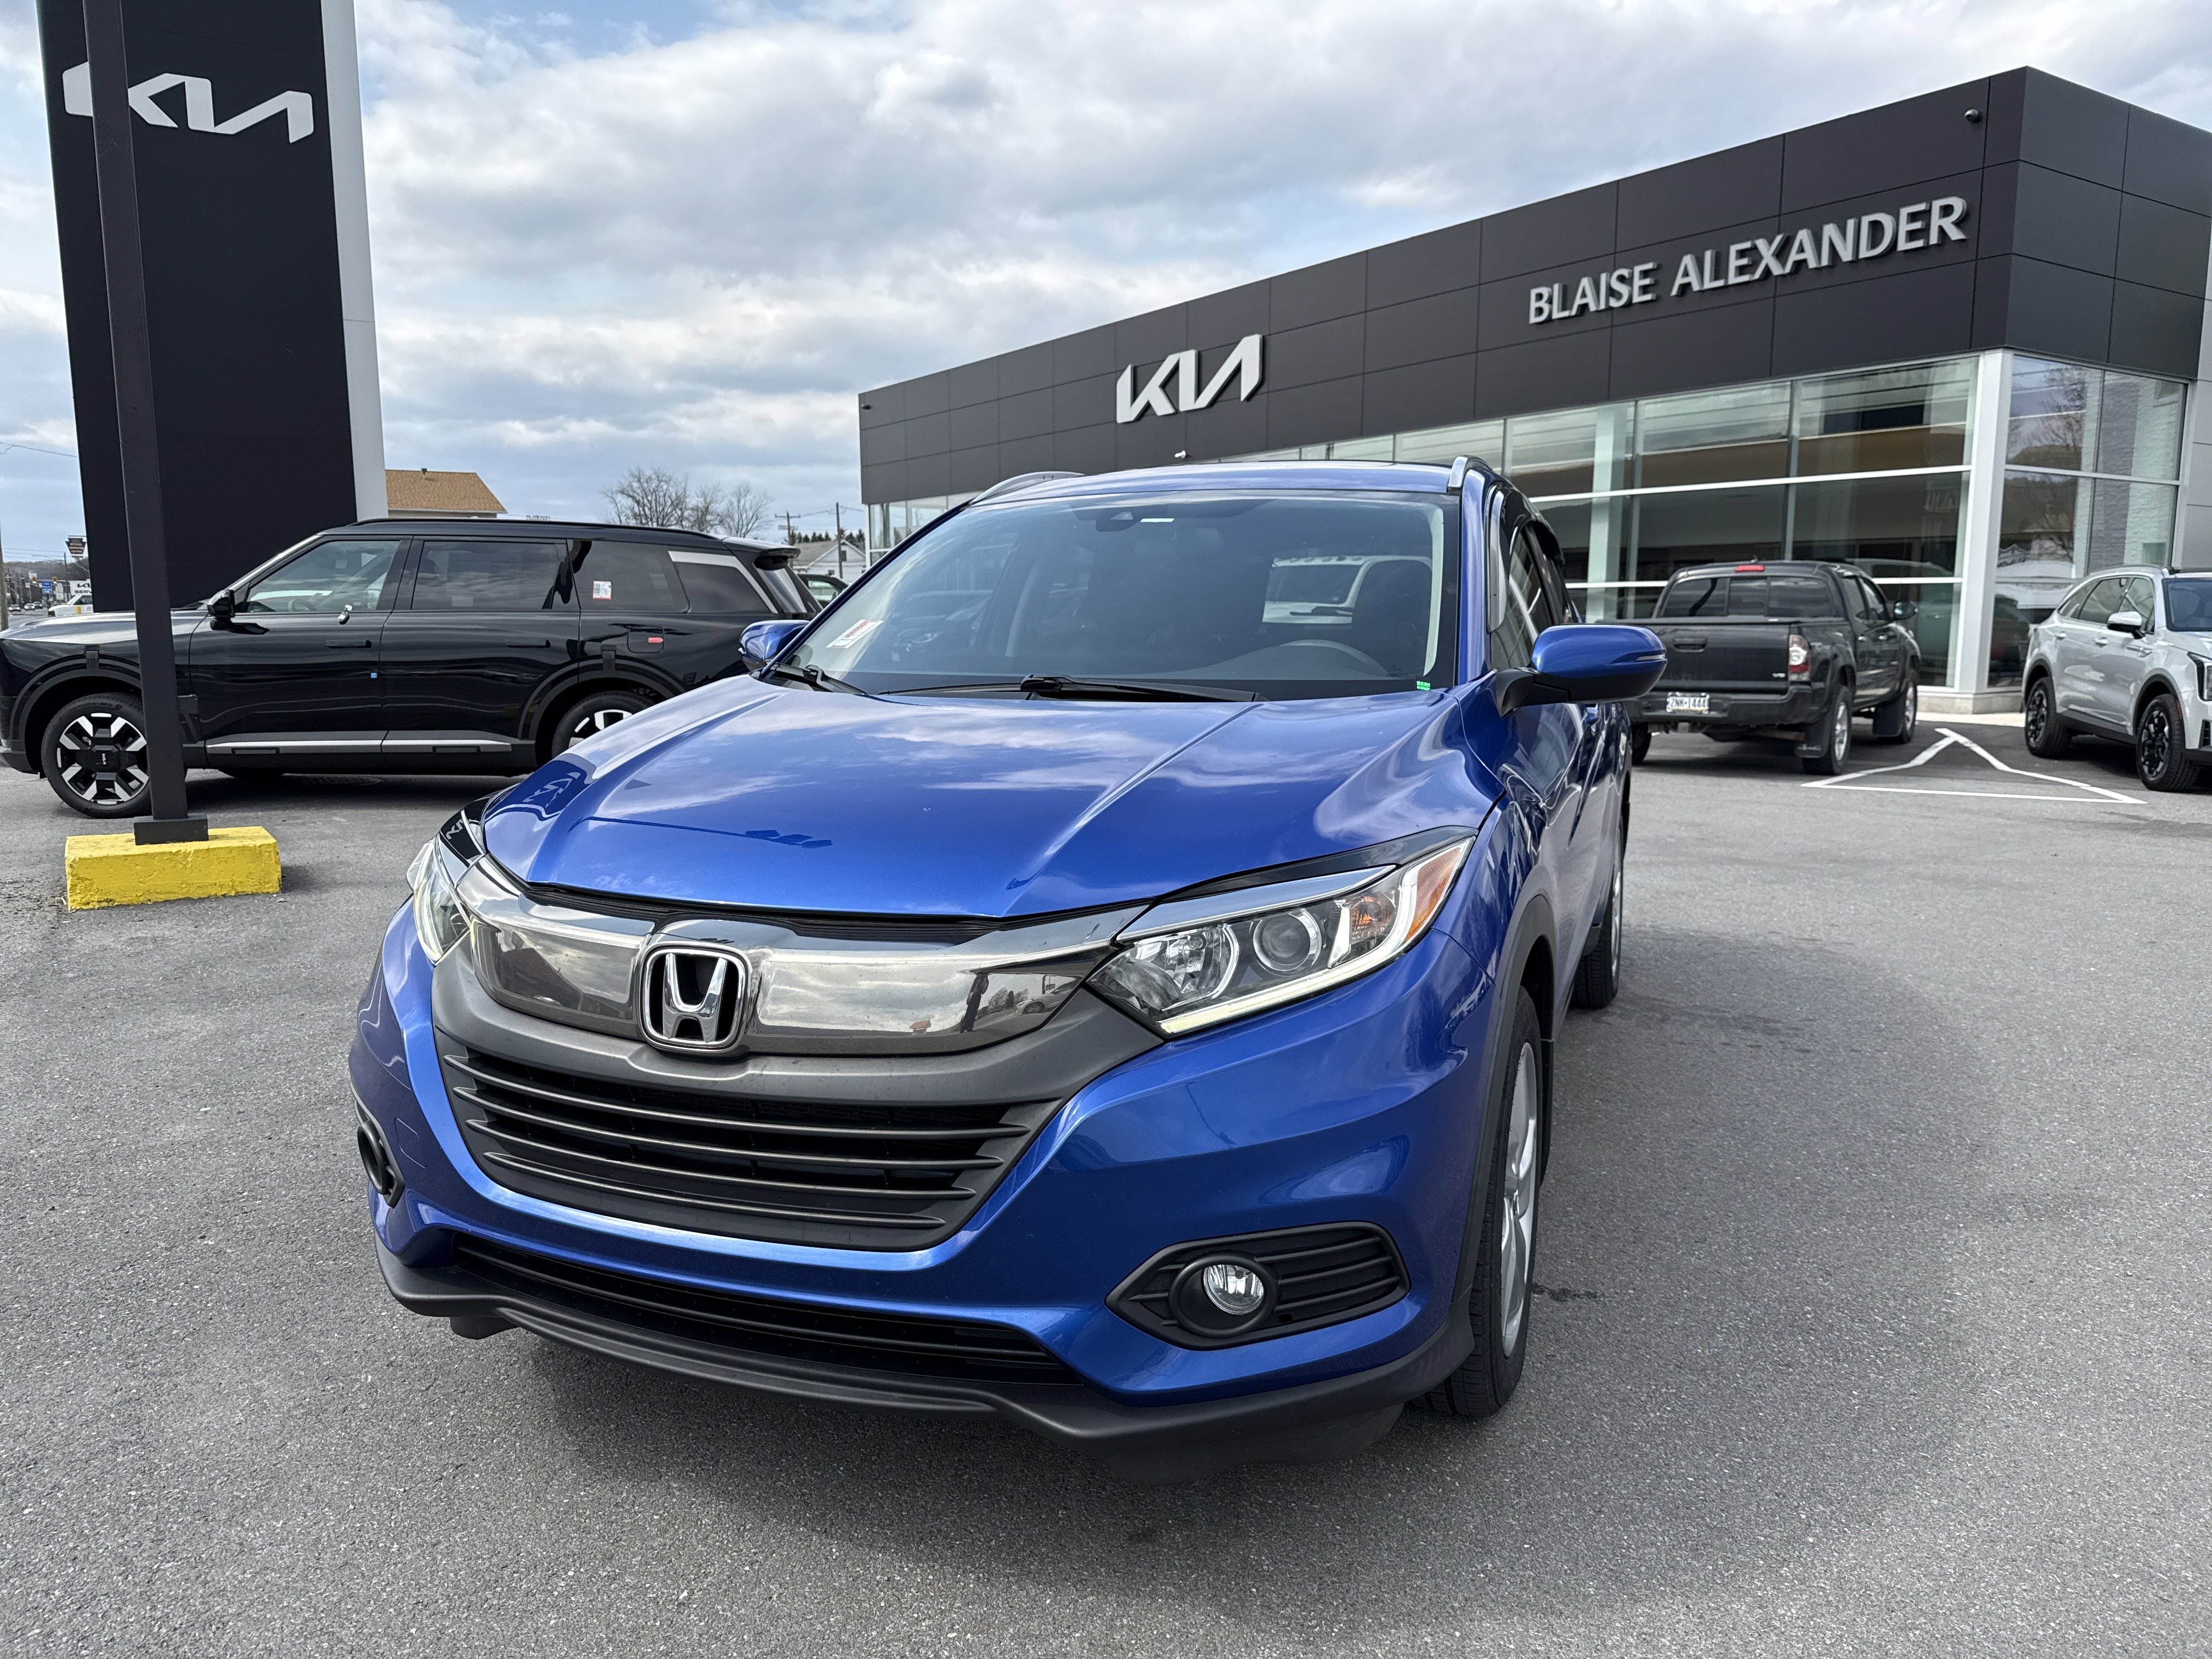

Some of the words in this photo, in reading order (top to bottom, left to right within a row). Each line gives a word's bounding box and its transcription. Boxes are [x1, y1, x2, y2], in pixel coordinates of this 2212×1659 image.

[63, 61, 314, 144] KIA
[1528, 262, 1657, 324] BLAISE
[1671, 196, 1967, 296] ALEXANDER
[1116, 334, 1262, 424] KIA
